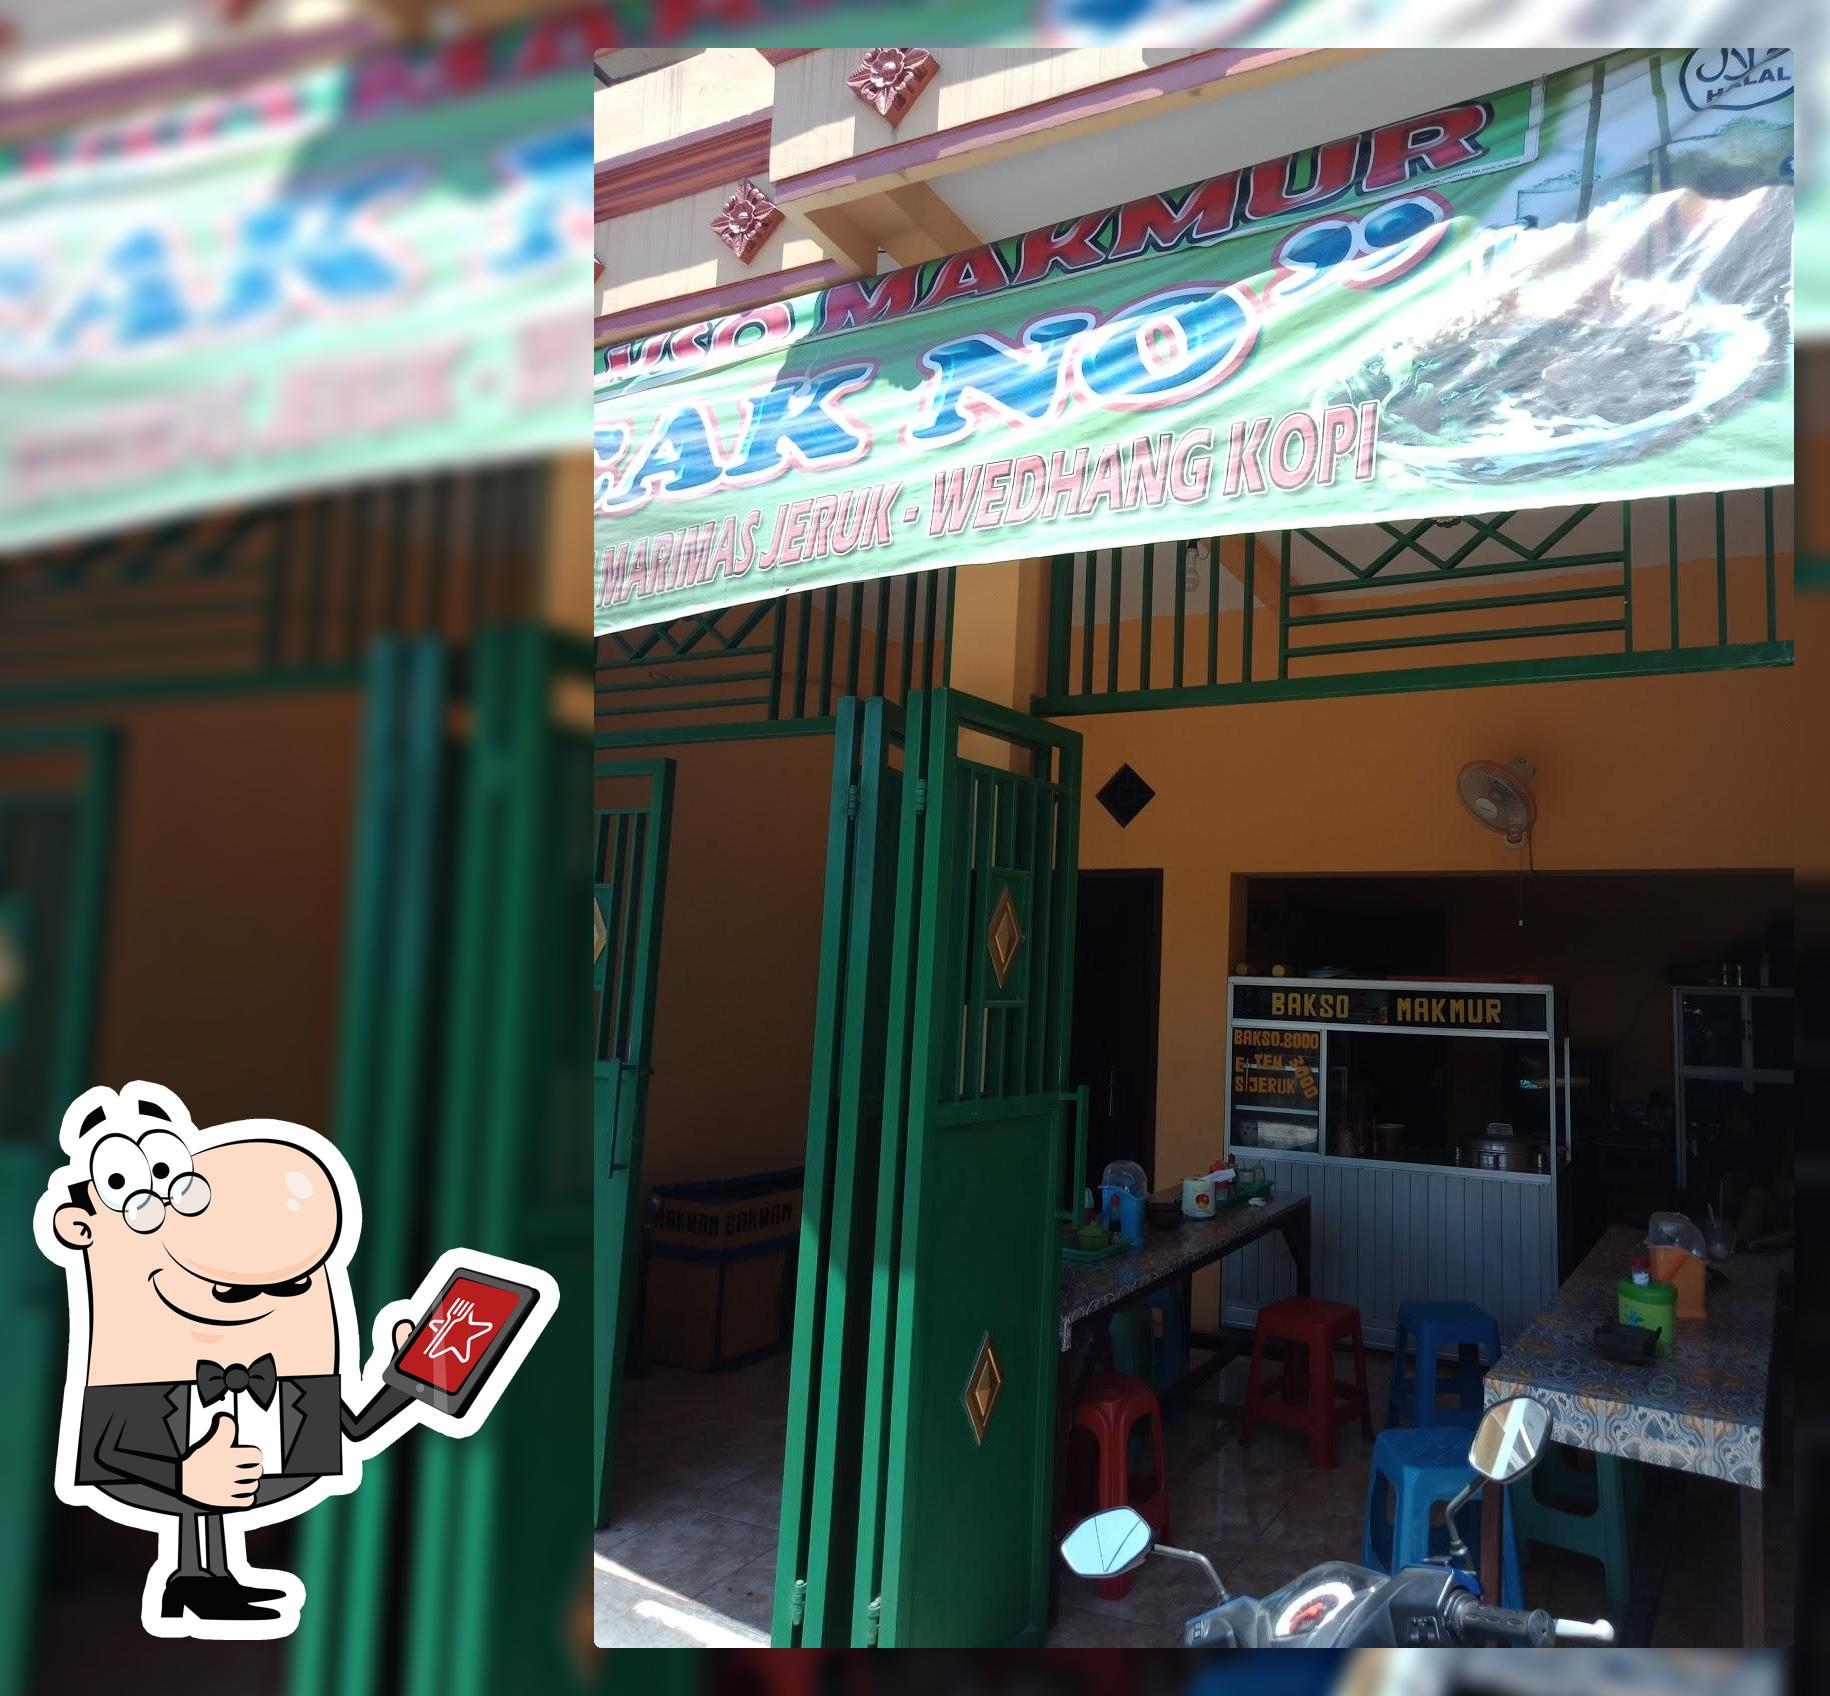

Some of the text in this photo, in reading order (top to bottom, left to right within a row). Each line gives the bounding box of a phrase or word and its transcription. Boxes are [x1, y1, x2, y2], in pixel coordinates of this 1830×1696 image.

[816, 101, 1493, 333] MAKMUR
[595, 509, 762, 609] MARIMAS
[758, 480, 901, 571] JERUK
[929, 428, 1213, 536] WEDHANG
[1224, 401, 1381, 497] KOPI
[1271, 991, 1503, 1025] BAKSO MAKMUR
[1249, 1076, 1296, 1095] JERUK
